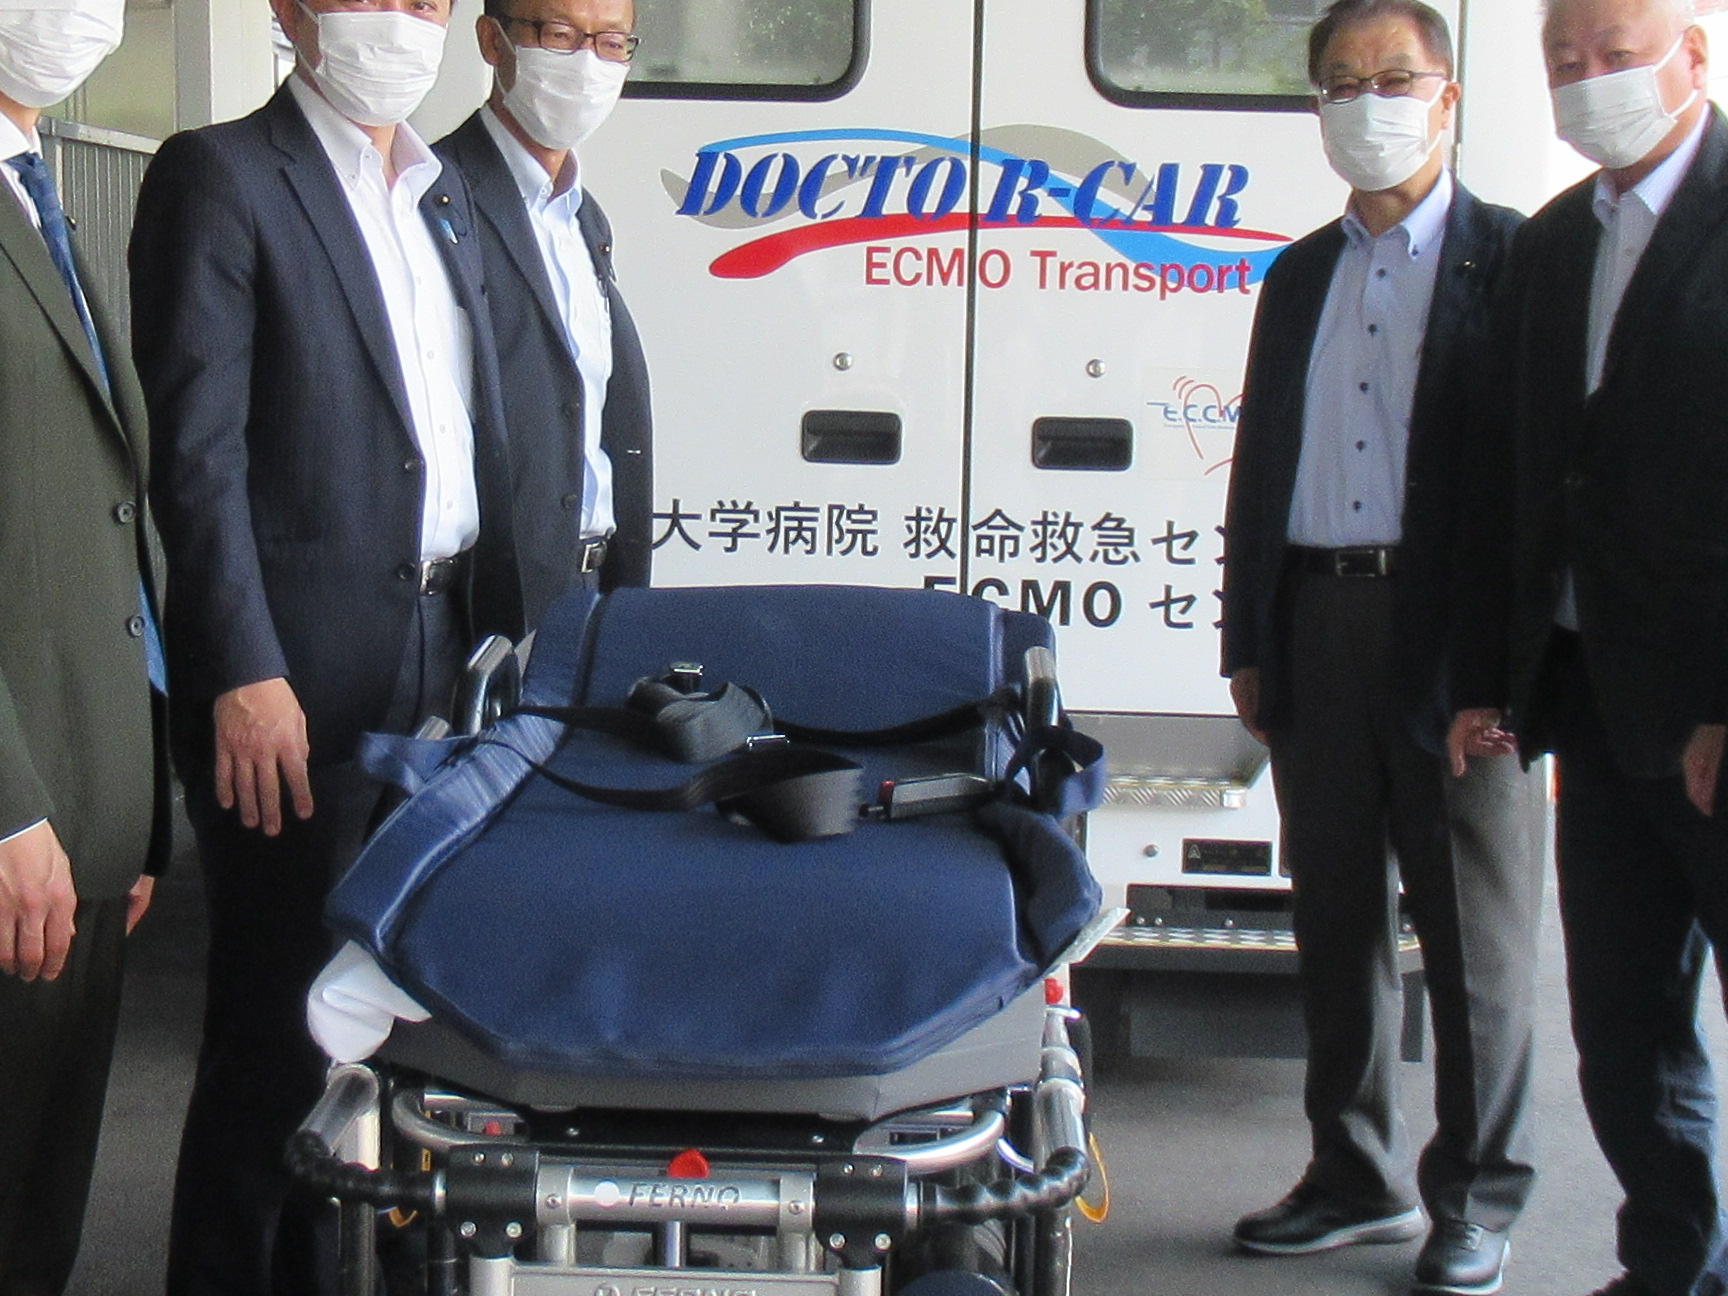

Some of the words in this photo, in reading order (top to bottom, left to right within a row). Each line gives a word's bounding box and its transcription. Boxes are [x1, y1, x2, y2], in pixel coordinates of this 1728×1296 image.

[864, 245, 1012, 290] ECMO
[1029, 250, 1252, 301] Transport
[652, 498, 880, 558] 大学病院
[923, 575, 1123, 629] MO
[628, 1181, 742, 1210] FERNO
